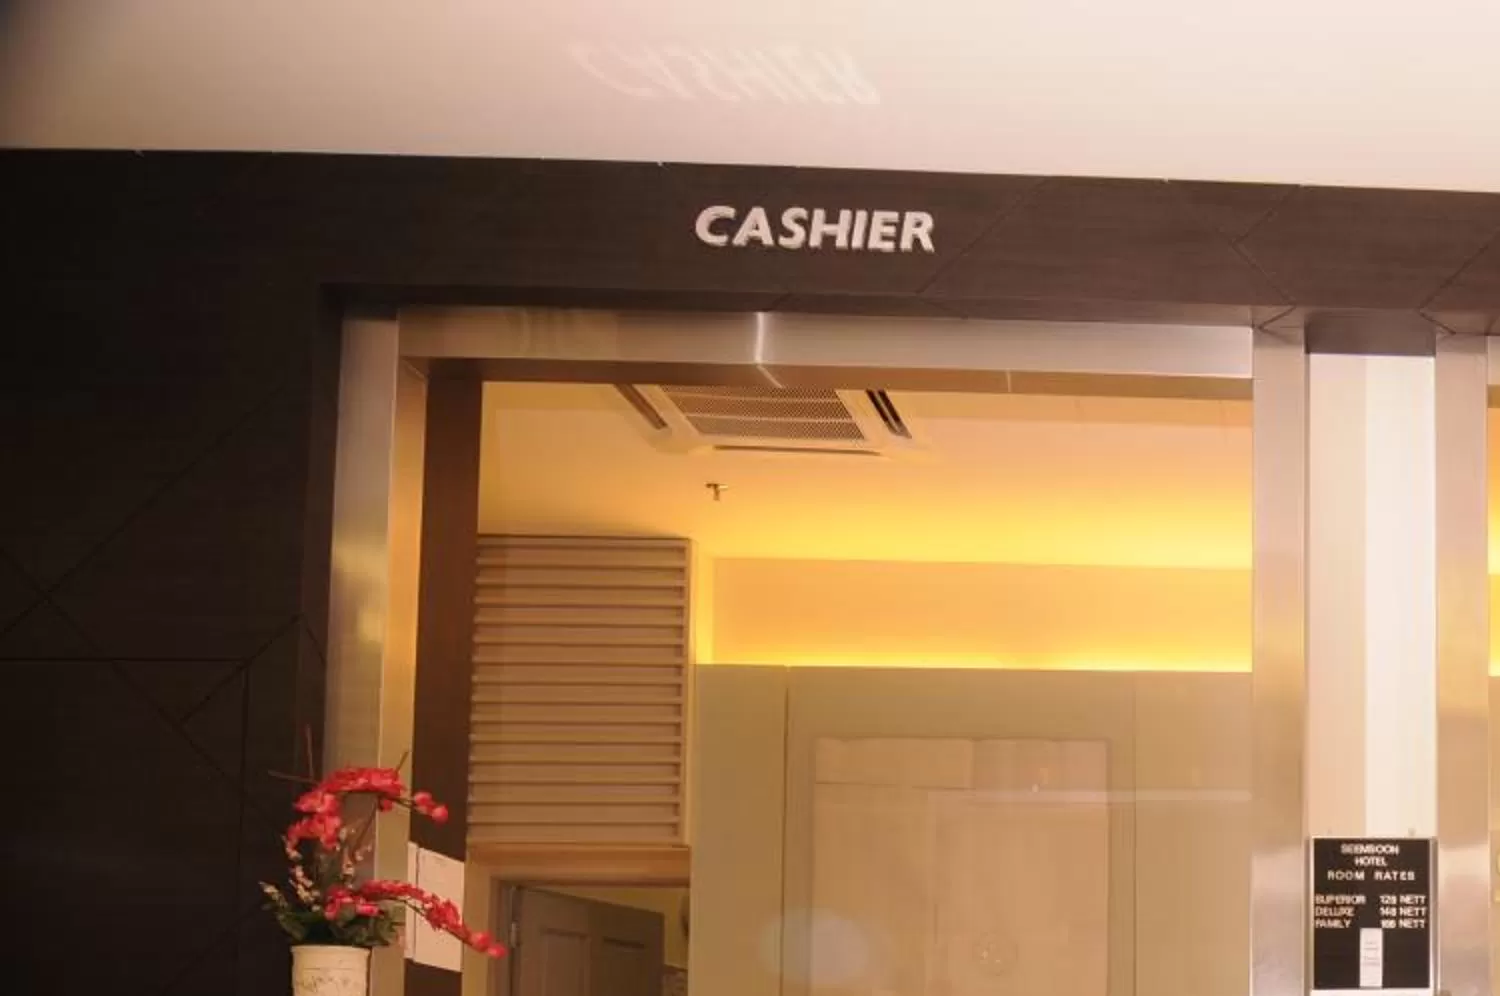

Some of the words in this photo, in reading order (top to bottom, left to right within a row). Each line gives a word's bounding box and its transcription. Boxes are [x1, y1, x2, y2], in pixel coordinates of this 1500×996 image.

[695, 205, 935, 252] CASHIER
[1355, 856, 1388, 867] HOTEL
[1327, 870, 1365, 880] ROOM
[1374, 870, 1415, 880] RATES
[1314, 894, 1366, 905] SUPERIOR
[1399, 894, 1426, 904] NETT
[1314, 906, 1355, 916] DELUXE
[1399, 906, 1426, 916] NETT
[1314, 918, 1351, 928] FAMILY
[1399, 918, 1425, 928] NETT
